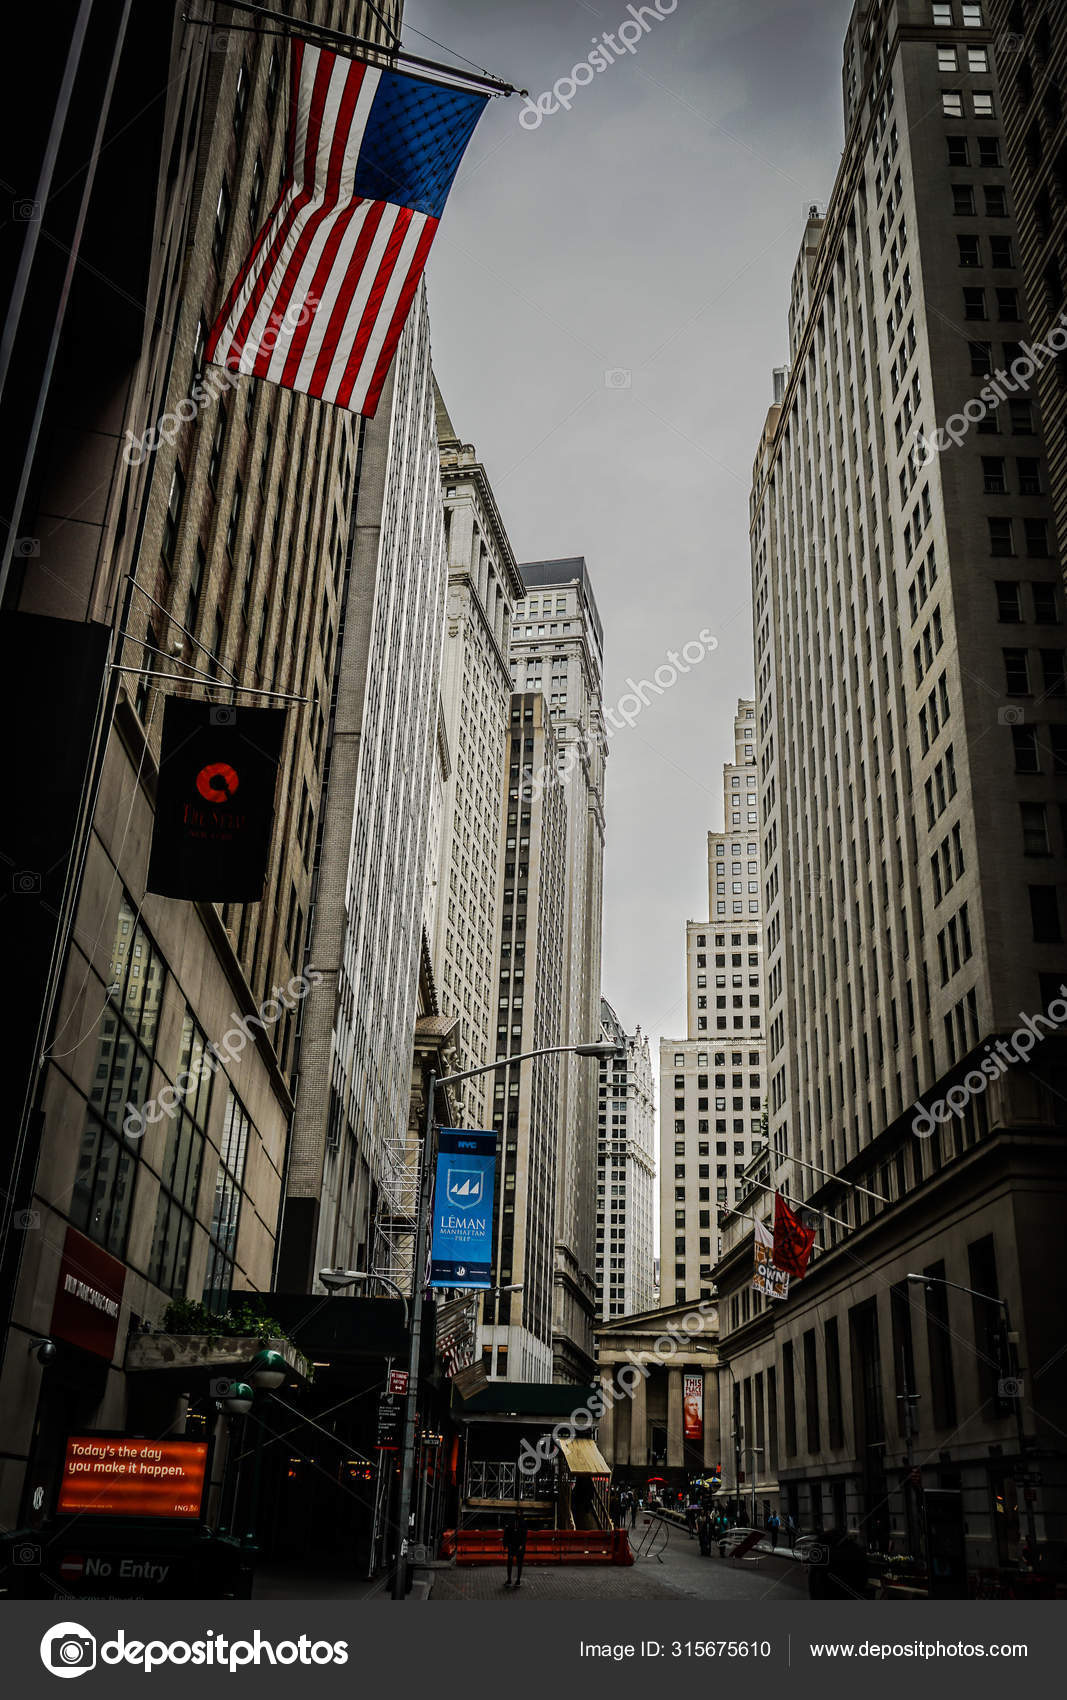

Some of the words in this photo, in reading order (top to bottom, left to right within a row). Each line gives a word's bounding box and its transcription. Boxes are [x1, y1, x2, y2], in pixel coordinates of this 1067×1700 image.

[457, 1140, 477, 1149] NYC
[686, 1378, 702, 1387] THIS
[71, 1443, 115, 1460] Today's
[118, 1445, 138, 1458] the
[139, 1447, 162, 1462] day
[68, 1461, 91, 1475] you
[93, 1461, 126, 1474] make
[128, 1461, 137, 1474] it
[139, 1462, 186, 1477] happen.
[174, 1504, 188, 1512] ING
[85, 1557, 113, 1577] No
[119, 1559, 170, 1584] Entry
